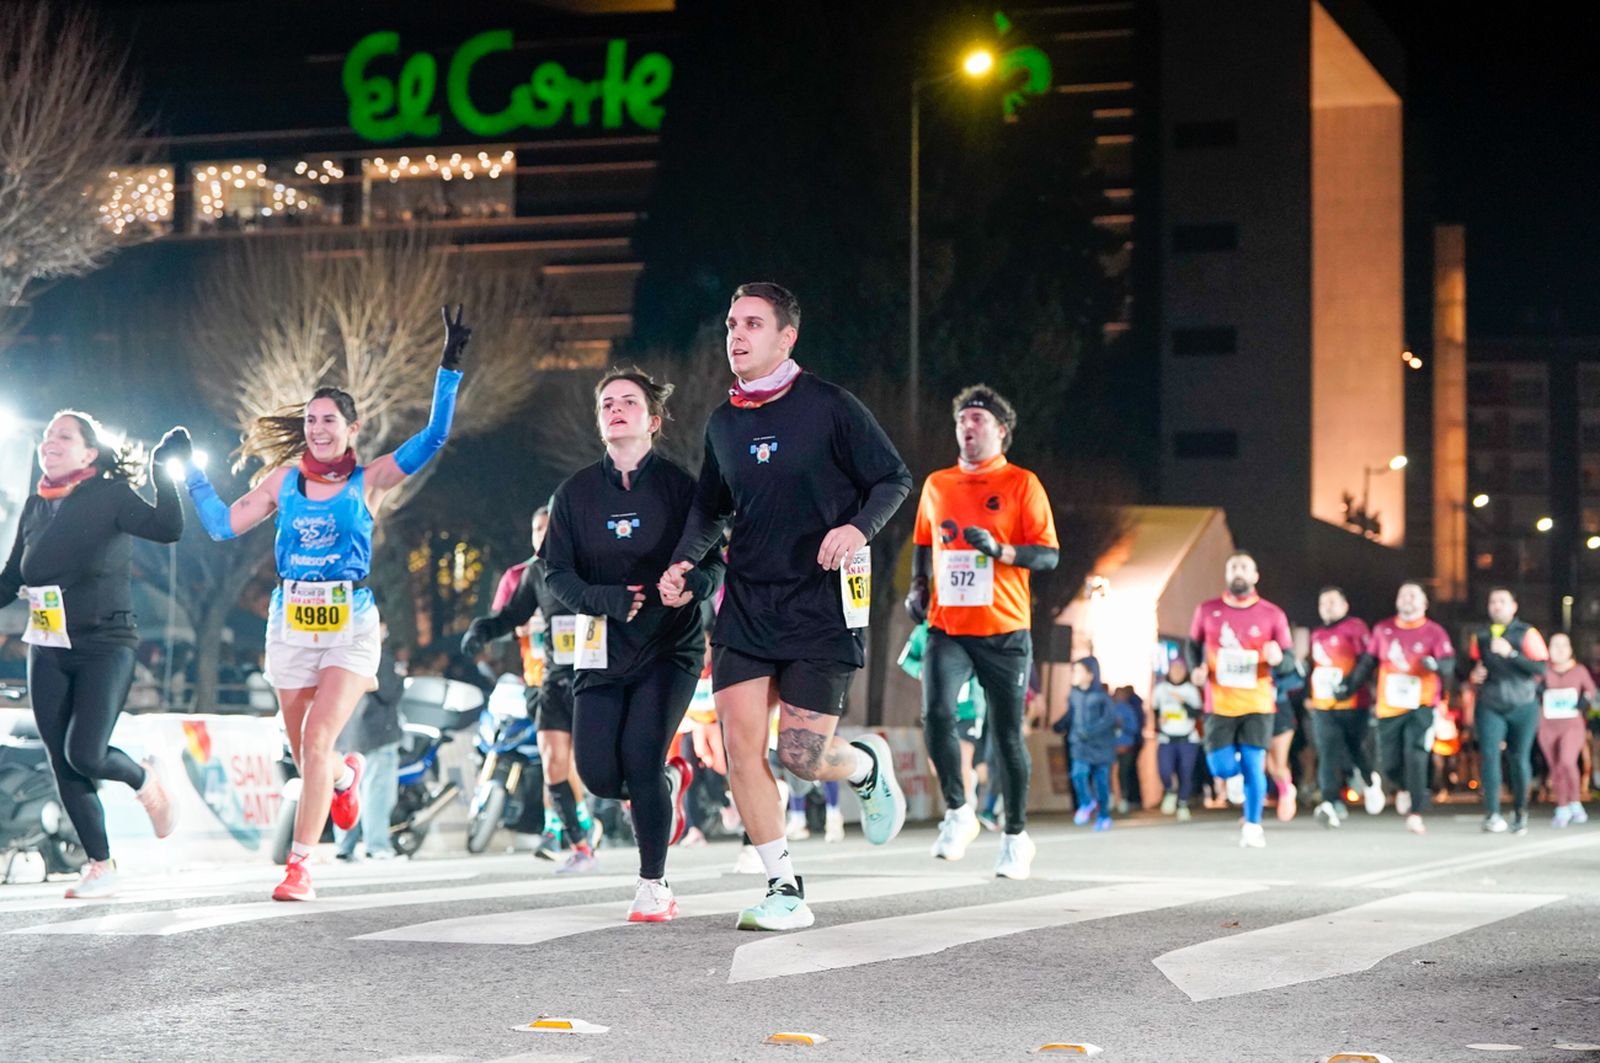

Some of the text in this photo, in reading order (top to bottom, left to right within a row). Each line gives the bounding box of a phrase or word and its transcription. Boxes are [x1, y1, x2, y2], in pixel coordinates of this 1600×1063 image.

[343, 29, 673, 140] El Corte
[951, 571, 975, 587] 572
[295, 606, 340, 625] 4980
[233, 755, 271, 786] SAN
[244, 793, 284, 824] ANT
